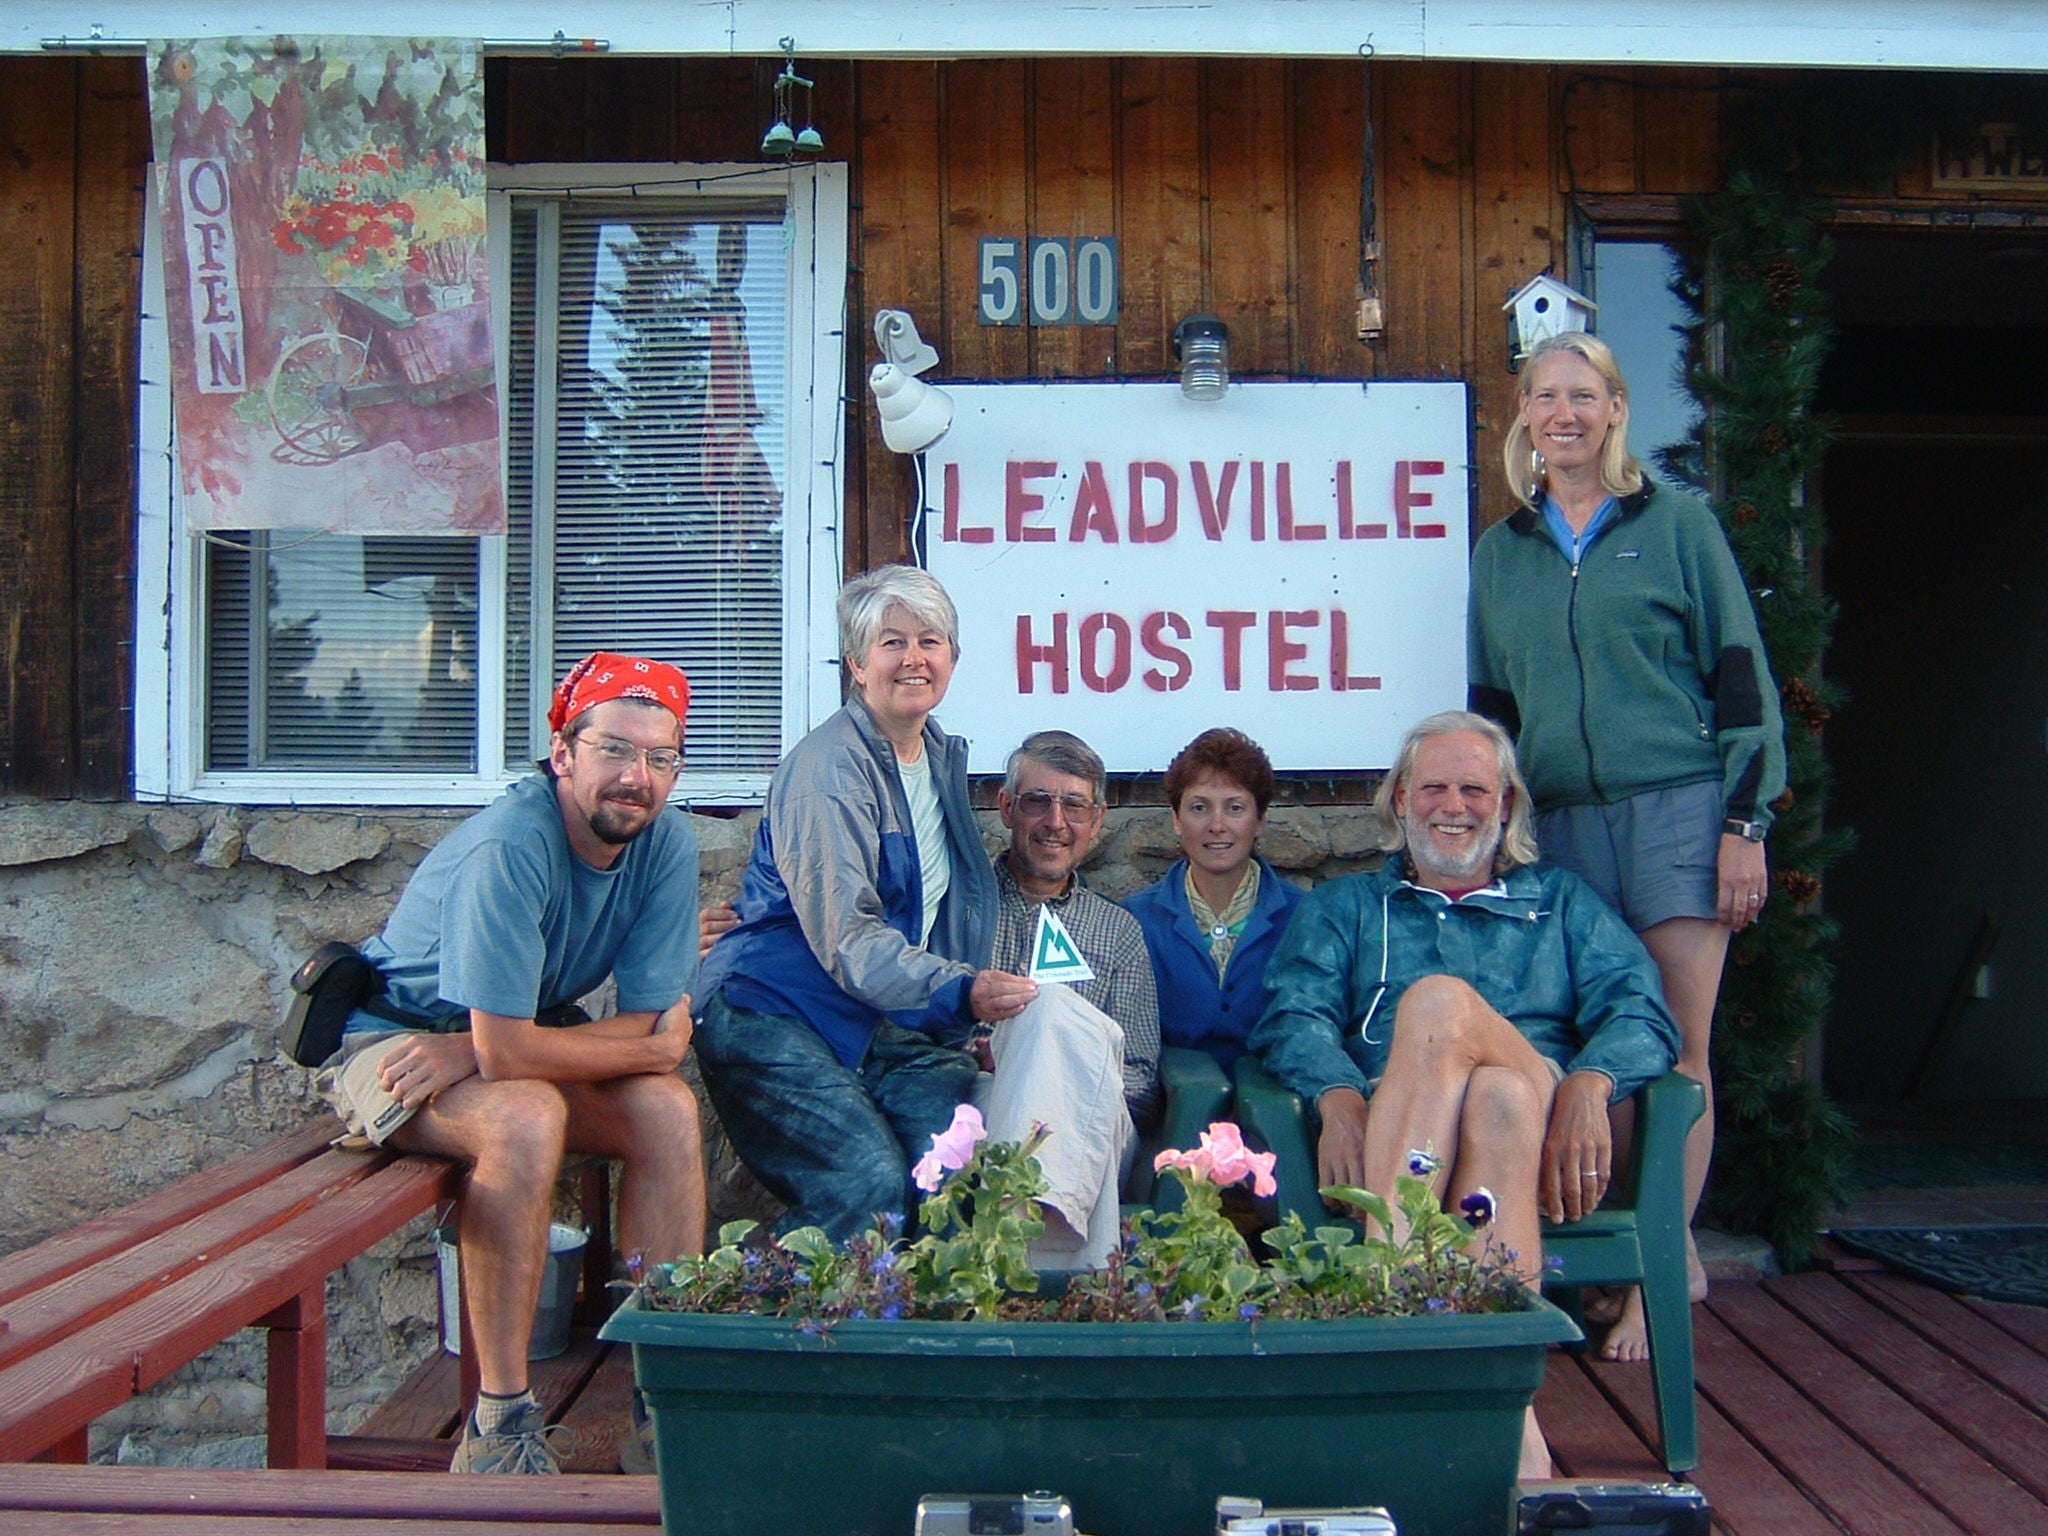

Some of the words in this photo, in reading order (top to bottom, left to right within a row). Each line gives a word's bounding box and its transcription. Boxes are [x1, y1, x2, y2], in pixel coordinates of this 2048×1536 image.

[188, 160, 242, 387] OPEN
[981, 241, 1113, 321] 500
[942, 460, 1446, 544] LEADVILLE
[1016, 609, 1382, 694] HOSTEL
